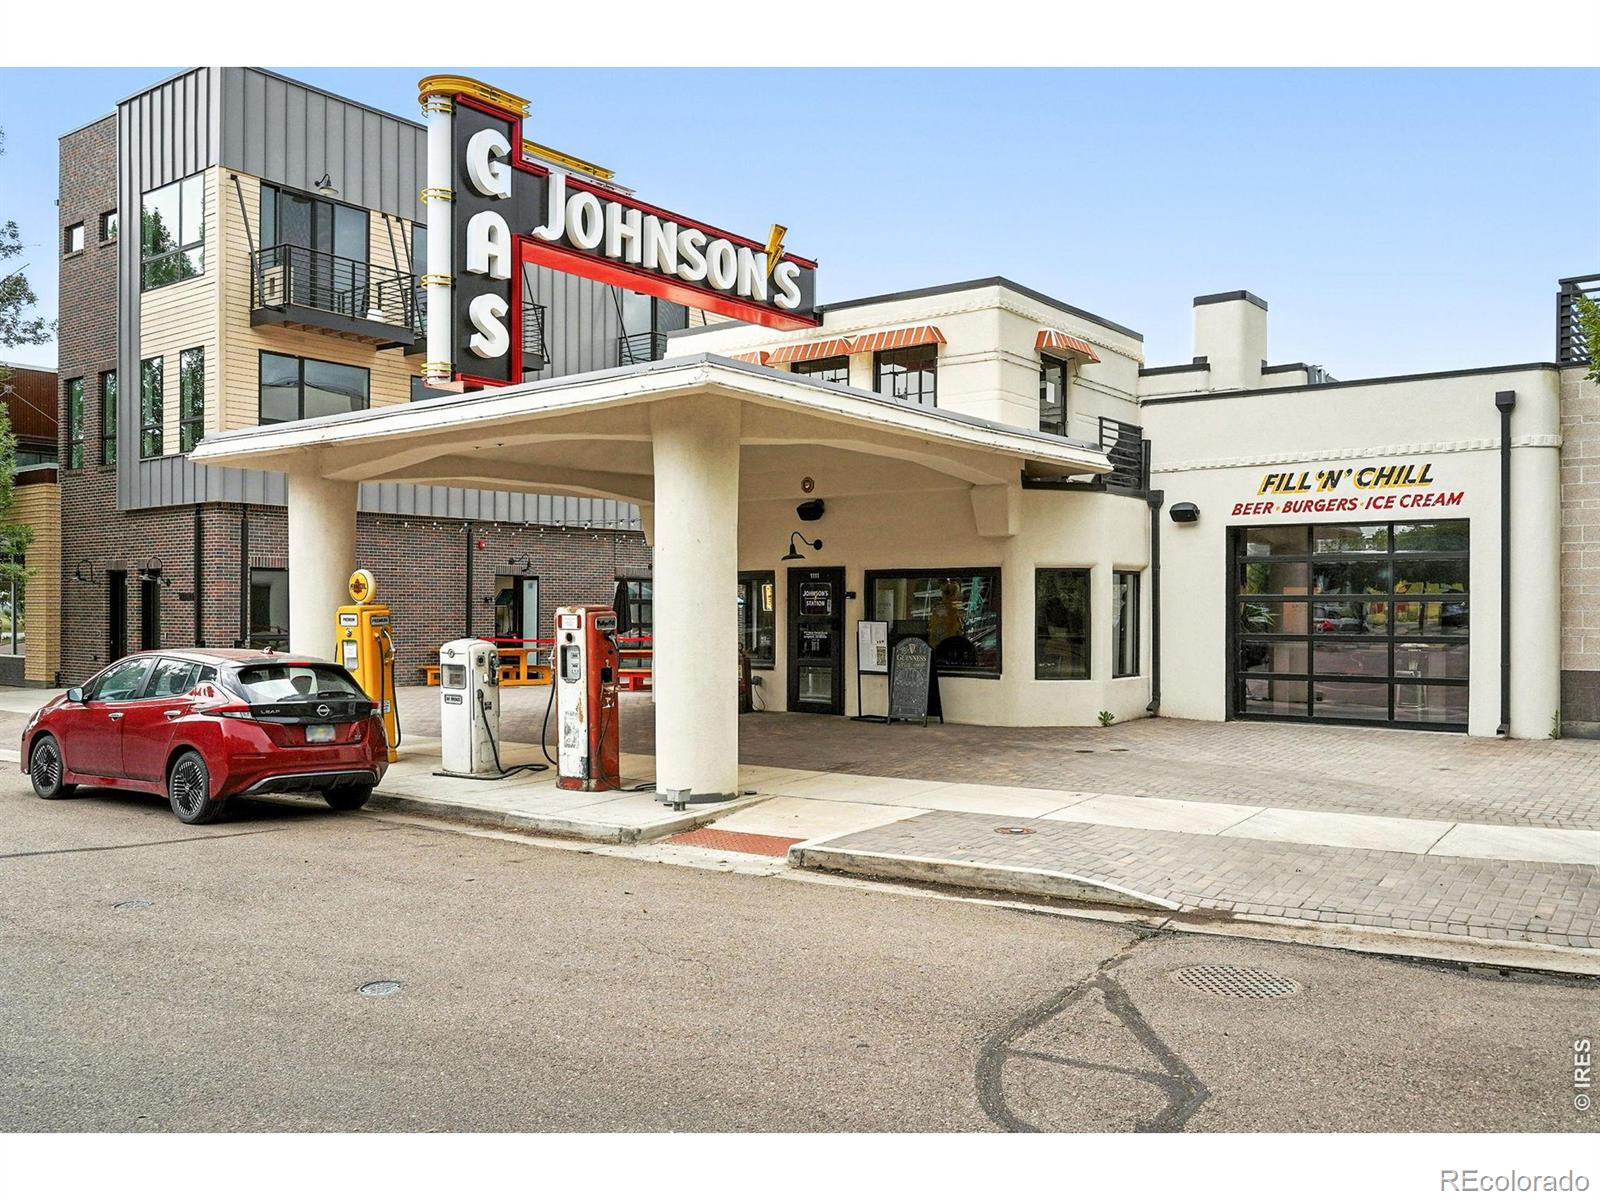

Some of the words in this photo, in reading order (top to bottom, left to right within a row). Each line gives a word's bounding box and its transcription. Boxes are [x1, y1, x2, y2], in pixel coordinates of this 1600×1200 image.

[466, 128, 512, 359] GAS
[532, 173, 801, 309] JOHNSON'S
[1231, 502, 1275, 516] BEER
[1281, 497, 1359, 514] BURGERS
[1365, 495, 1397, 510] ICE
[1399, 491, 1465, 508] CREAM
[1257, 472, 1312, 496] FILL
[1354, 463, 1434, 490] CHILL
